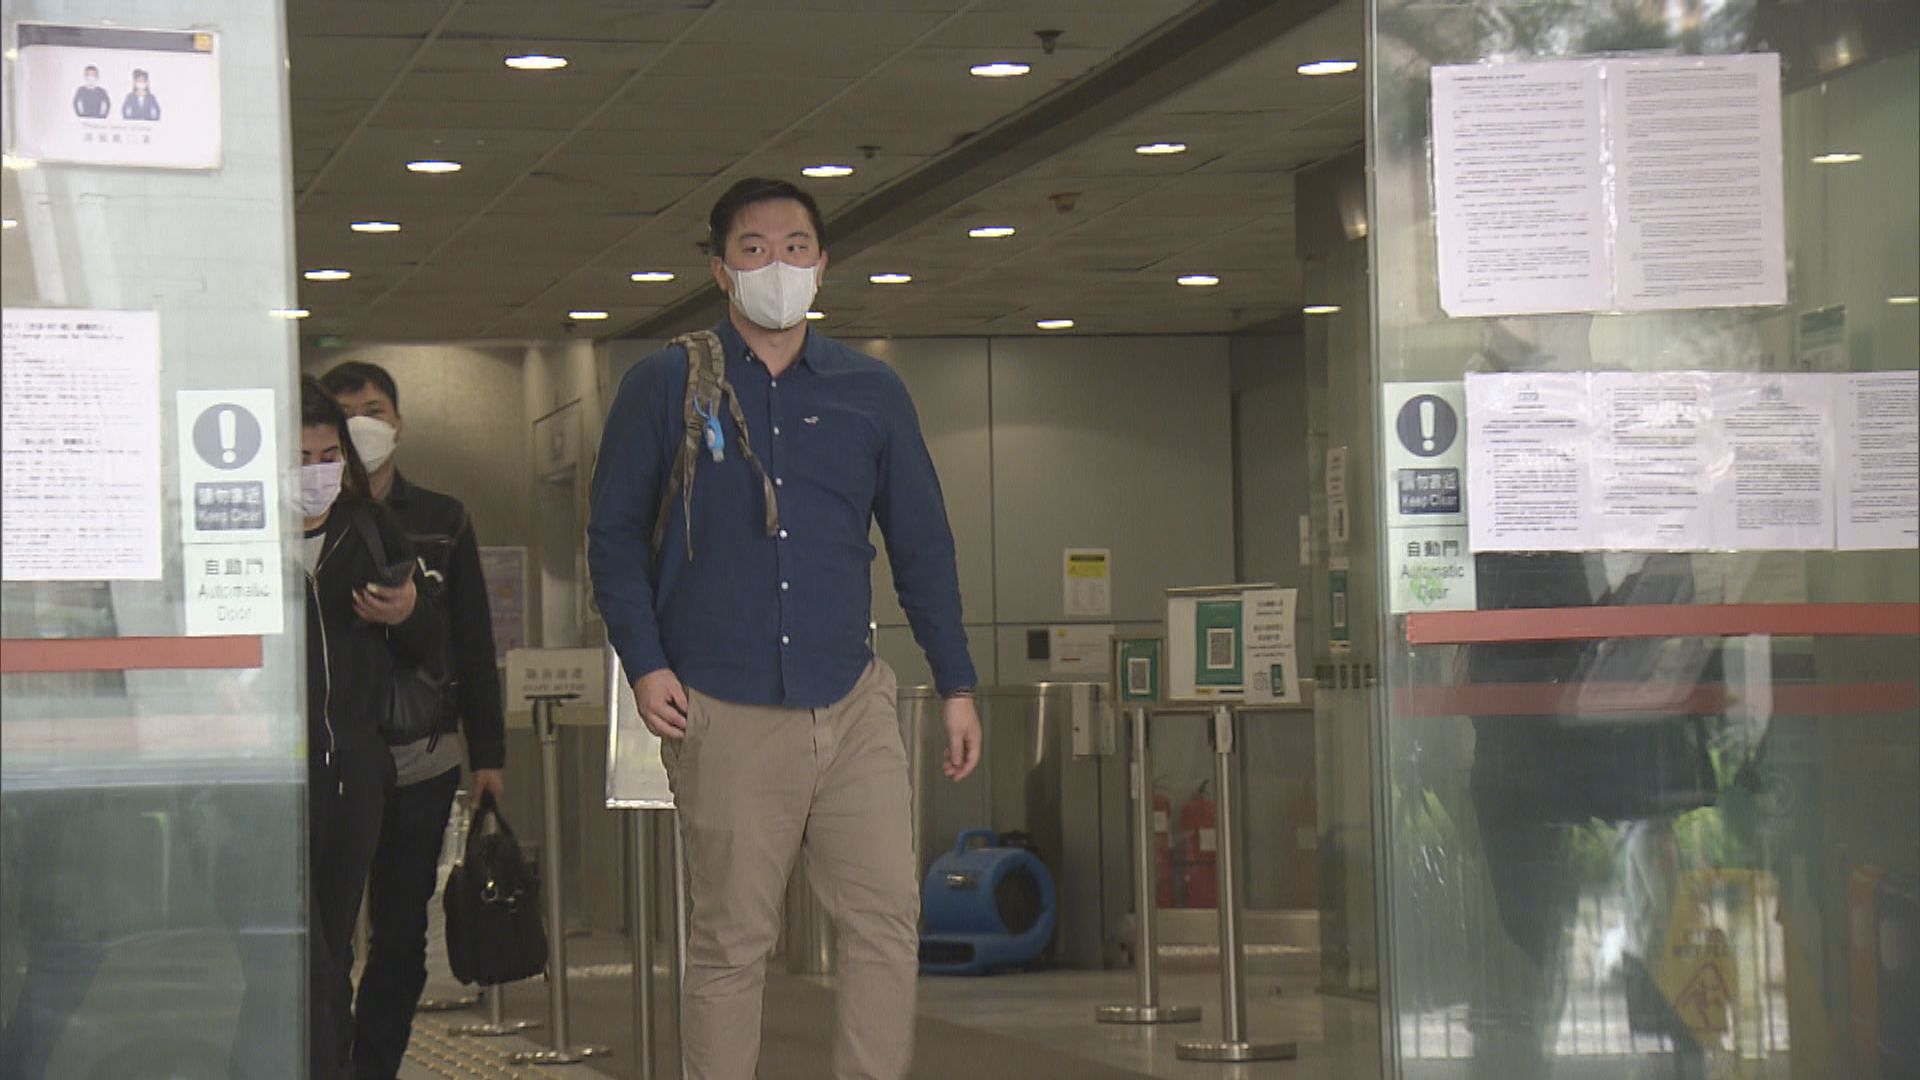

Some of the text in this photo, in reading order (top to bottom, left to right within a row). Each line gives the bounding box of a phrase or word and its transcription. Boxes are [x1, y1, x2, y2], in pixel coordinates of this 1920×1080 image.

[1408, 541, 1459, 557] 自動門
[206, 559, 264, 575] 自動門
[1400, 564, 1465, 579] Automatic
[198, 584, 270, 599] Automatic
[217, 605, 252, 621] Door
